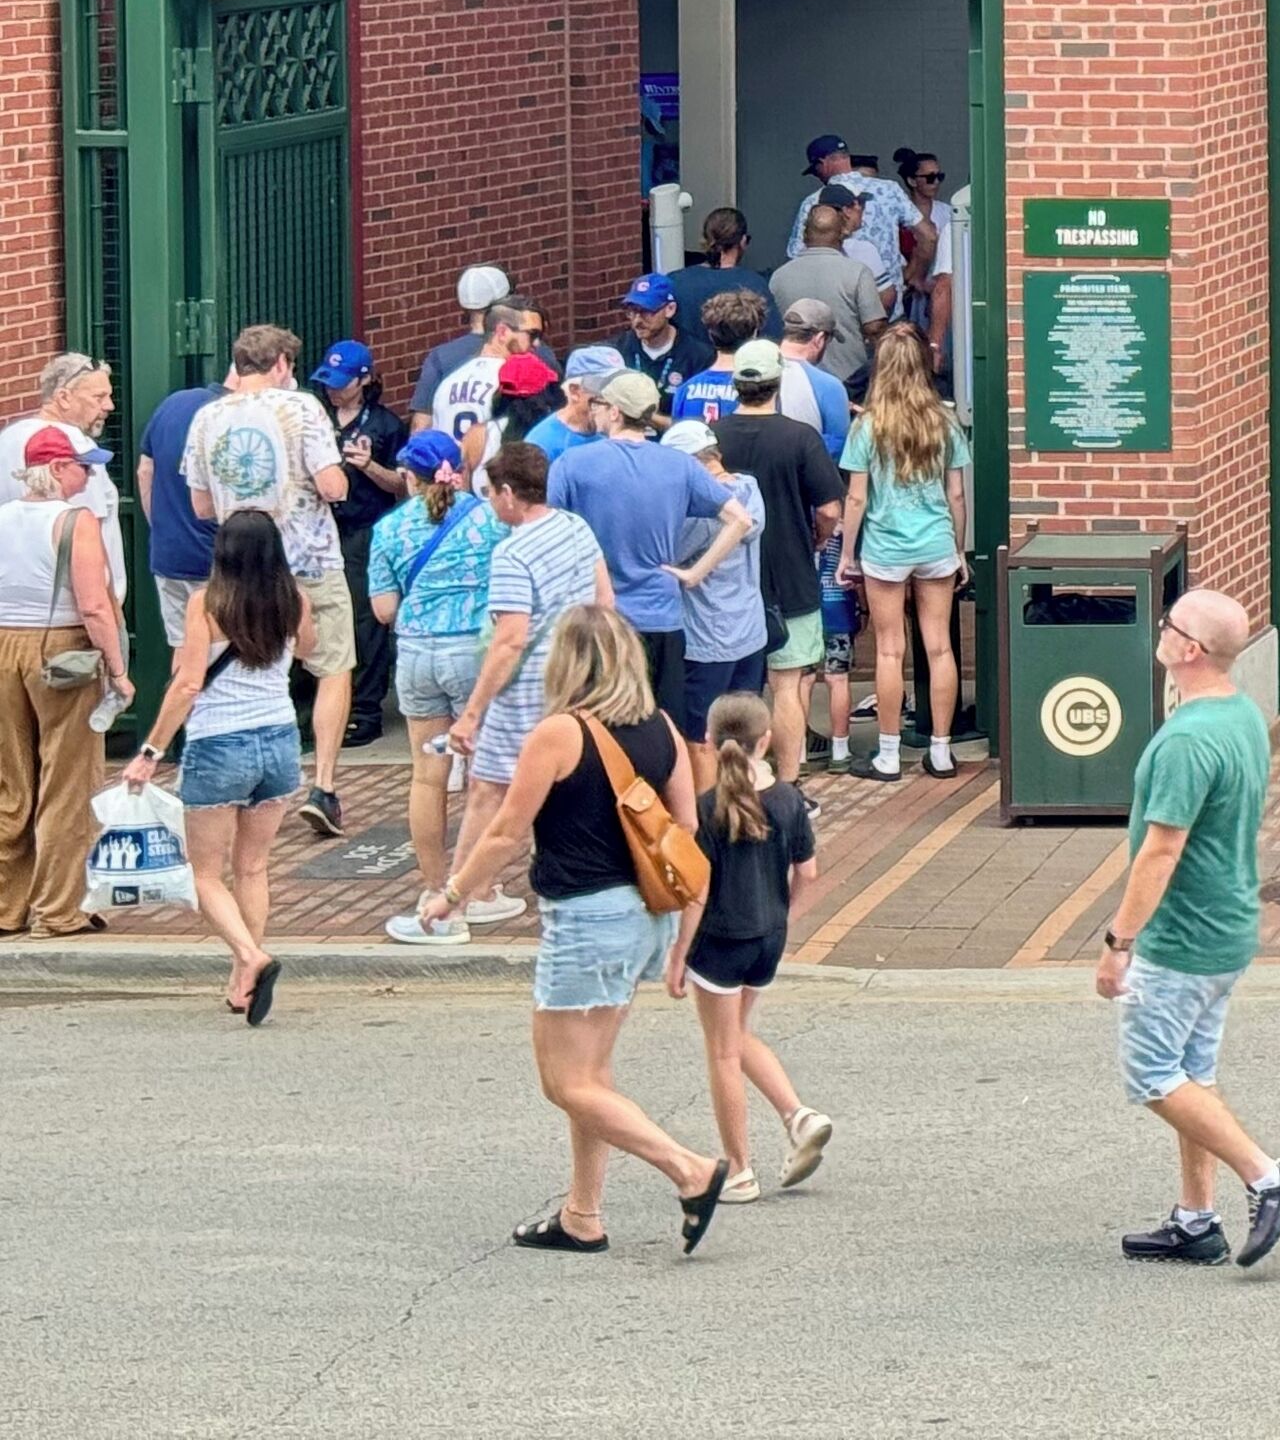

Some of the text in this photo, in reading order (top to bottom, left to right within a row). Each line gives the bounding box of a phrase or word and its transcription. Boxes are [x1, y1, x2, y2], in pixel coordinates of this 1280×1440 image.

[1087, 210, 1106, 226] NO
[1055, 228, 1139, 246] TRESPASSING
[448, 378, 494, 407] BAEZ
[1052, 687, 1110, 745] CUBS
[342, 844, 387, 860] JOE
